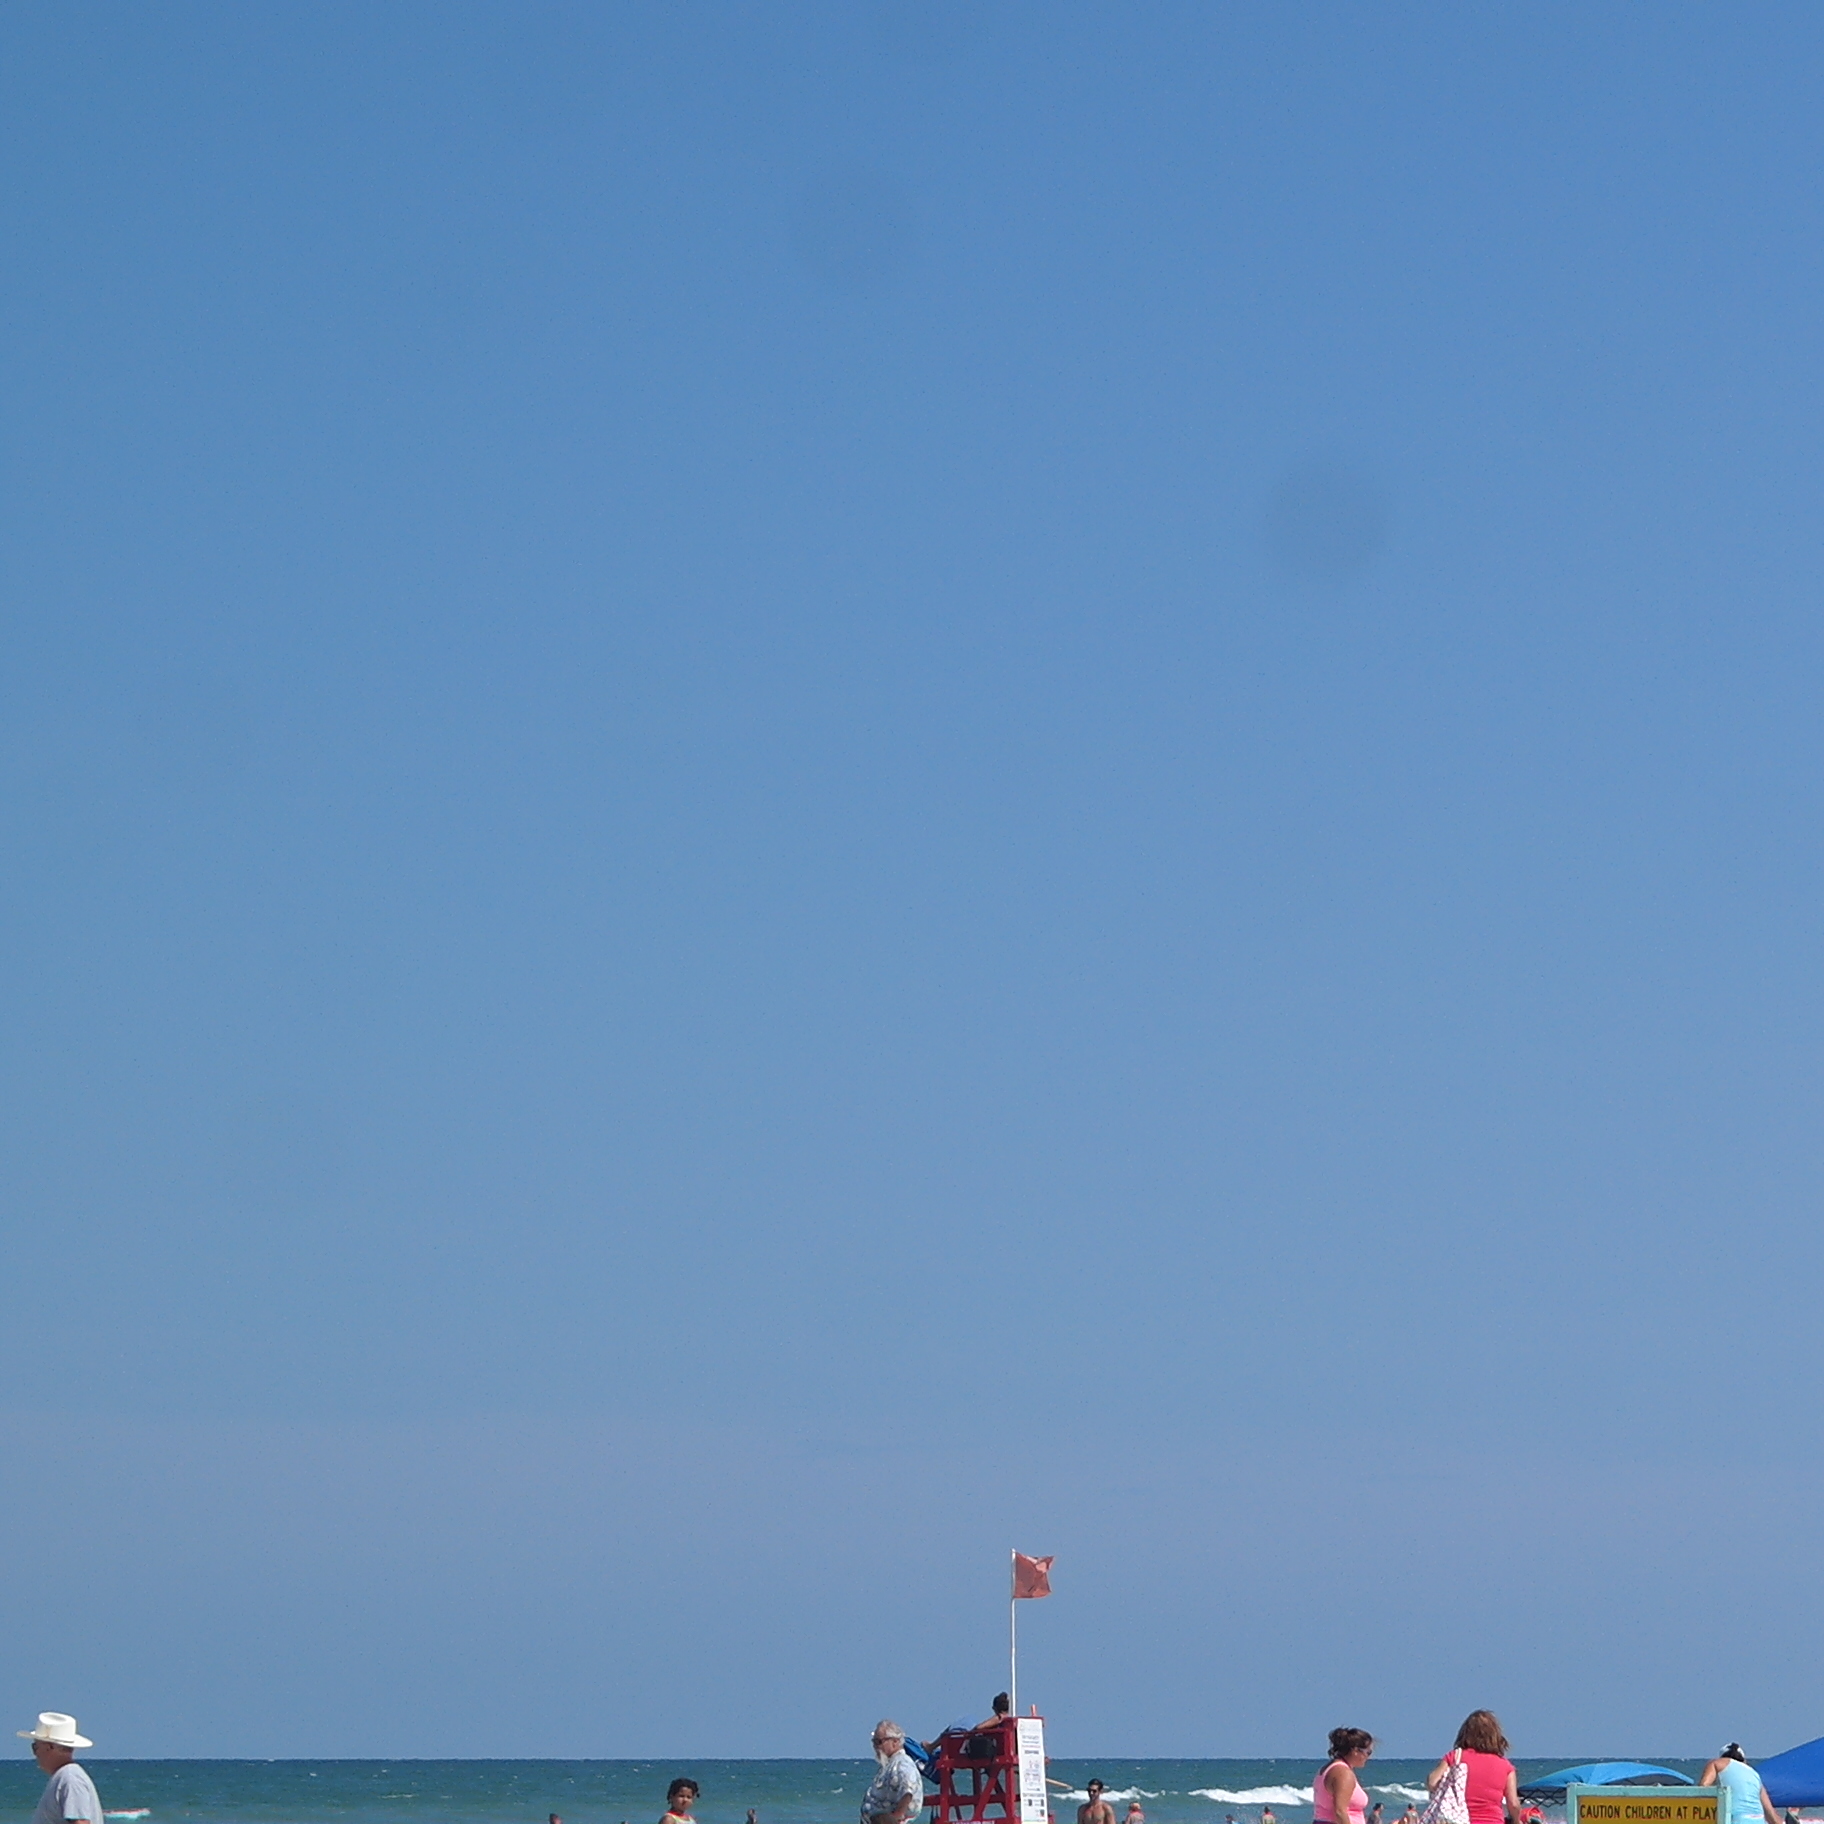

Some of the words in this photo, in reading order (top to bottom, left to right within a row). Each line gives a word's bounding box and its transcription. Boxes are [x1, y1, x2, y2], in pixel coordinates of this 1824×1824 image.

[1580, 1804, 1620, 1819] CAUTION
[1625, 1805, 1672, 1820] CHILDREN
[1676, 1806, 1688, 1820] AT
[1692, 1806, 1717, 1820] PLAY
